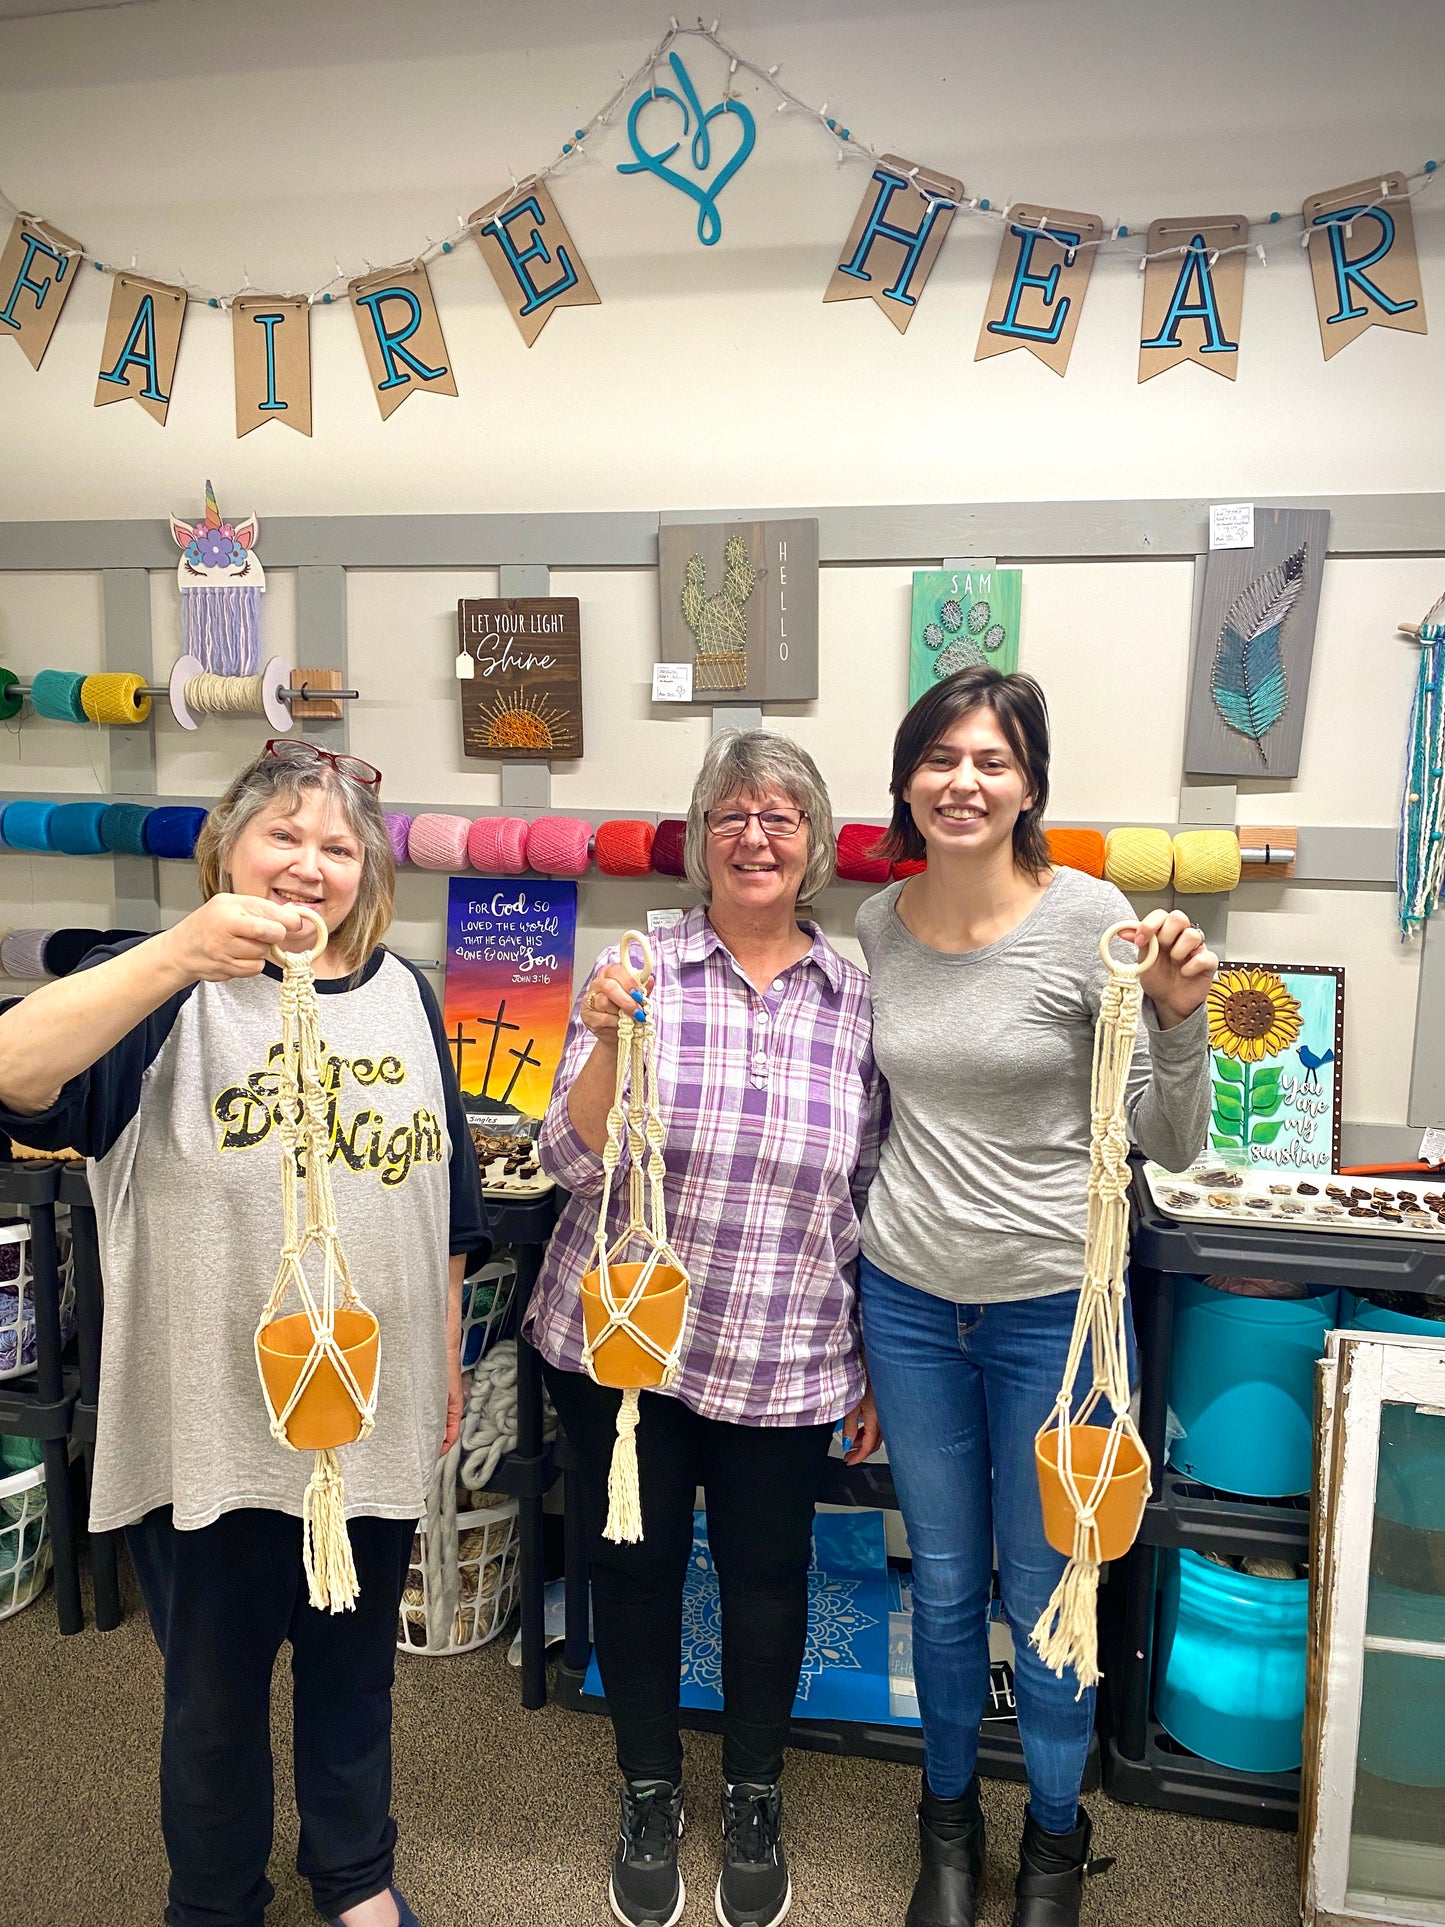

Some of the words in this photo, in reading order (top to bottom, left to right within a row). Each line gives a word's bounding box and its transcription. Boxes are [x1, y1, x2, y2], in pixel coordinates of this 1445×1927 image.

[950, 573, 991, 595] SAM
[779, 541, 789, 661] HELLO
[471, 614, 490, 633] LET
[494, 614, 525, 633] YOUR
[531, 614, 564, 633] LIGHT
[476, 632, 557, 677] Shine
[468, 901, 490, 914] FOR
[491, 893, 529, 917] God
[533, 900, 550, 912] SO
[460, 920, 492, 932] LOVED
[496, 922, 516, 931] THE
[519, 916, 559, 936] world
[463, 936, 483, 945] THAT
[485, 936, 496, 945] HE
[498, 935, 522, 946] GAVE
[526, 936, 543, 946] HIS
[463, 950, 481, 961] ONE
[497, 950, 519, 962] ONLY
[519, 947, 558, 971] Son
[511, 974, 531, 983] JOHN
[532, 974, 551, 984] 3:16
[247, 1040, 405, 1097] Tree
[1281, 1074, 1323, 1105] You
[467, 1115, 498, 1124] Singles
[1296, 1098, 1329, 1117] are
[1284, 1116, 1317, 1142] my
[1252, 1139, 1330, 1169] sunshine
